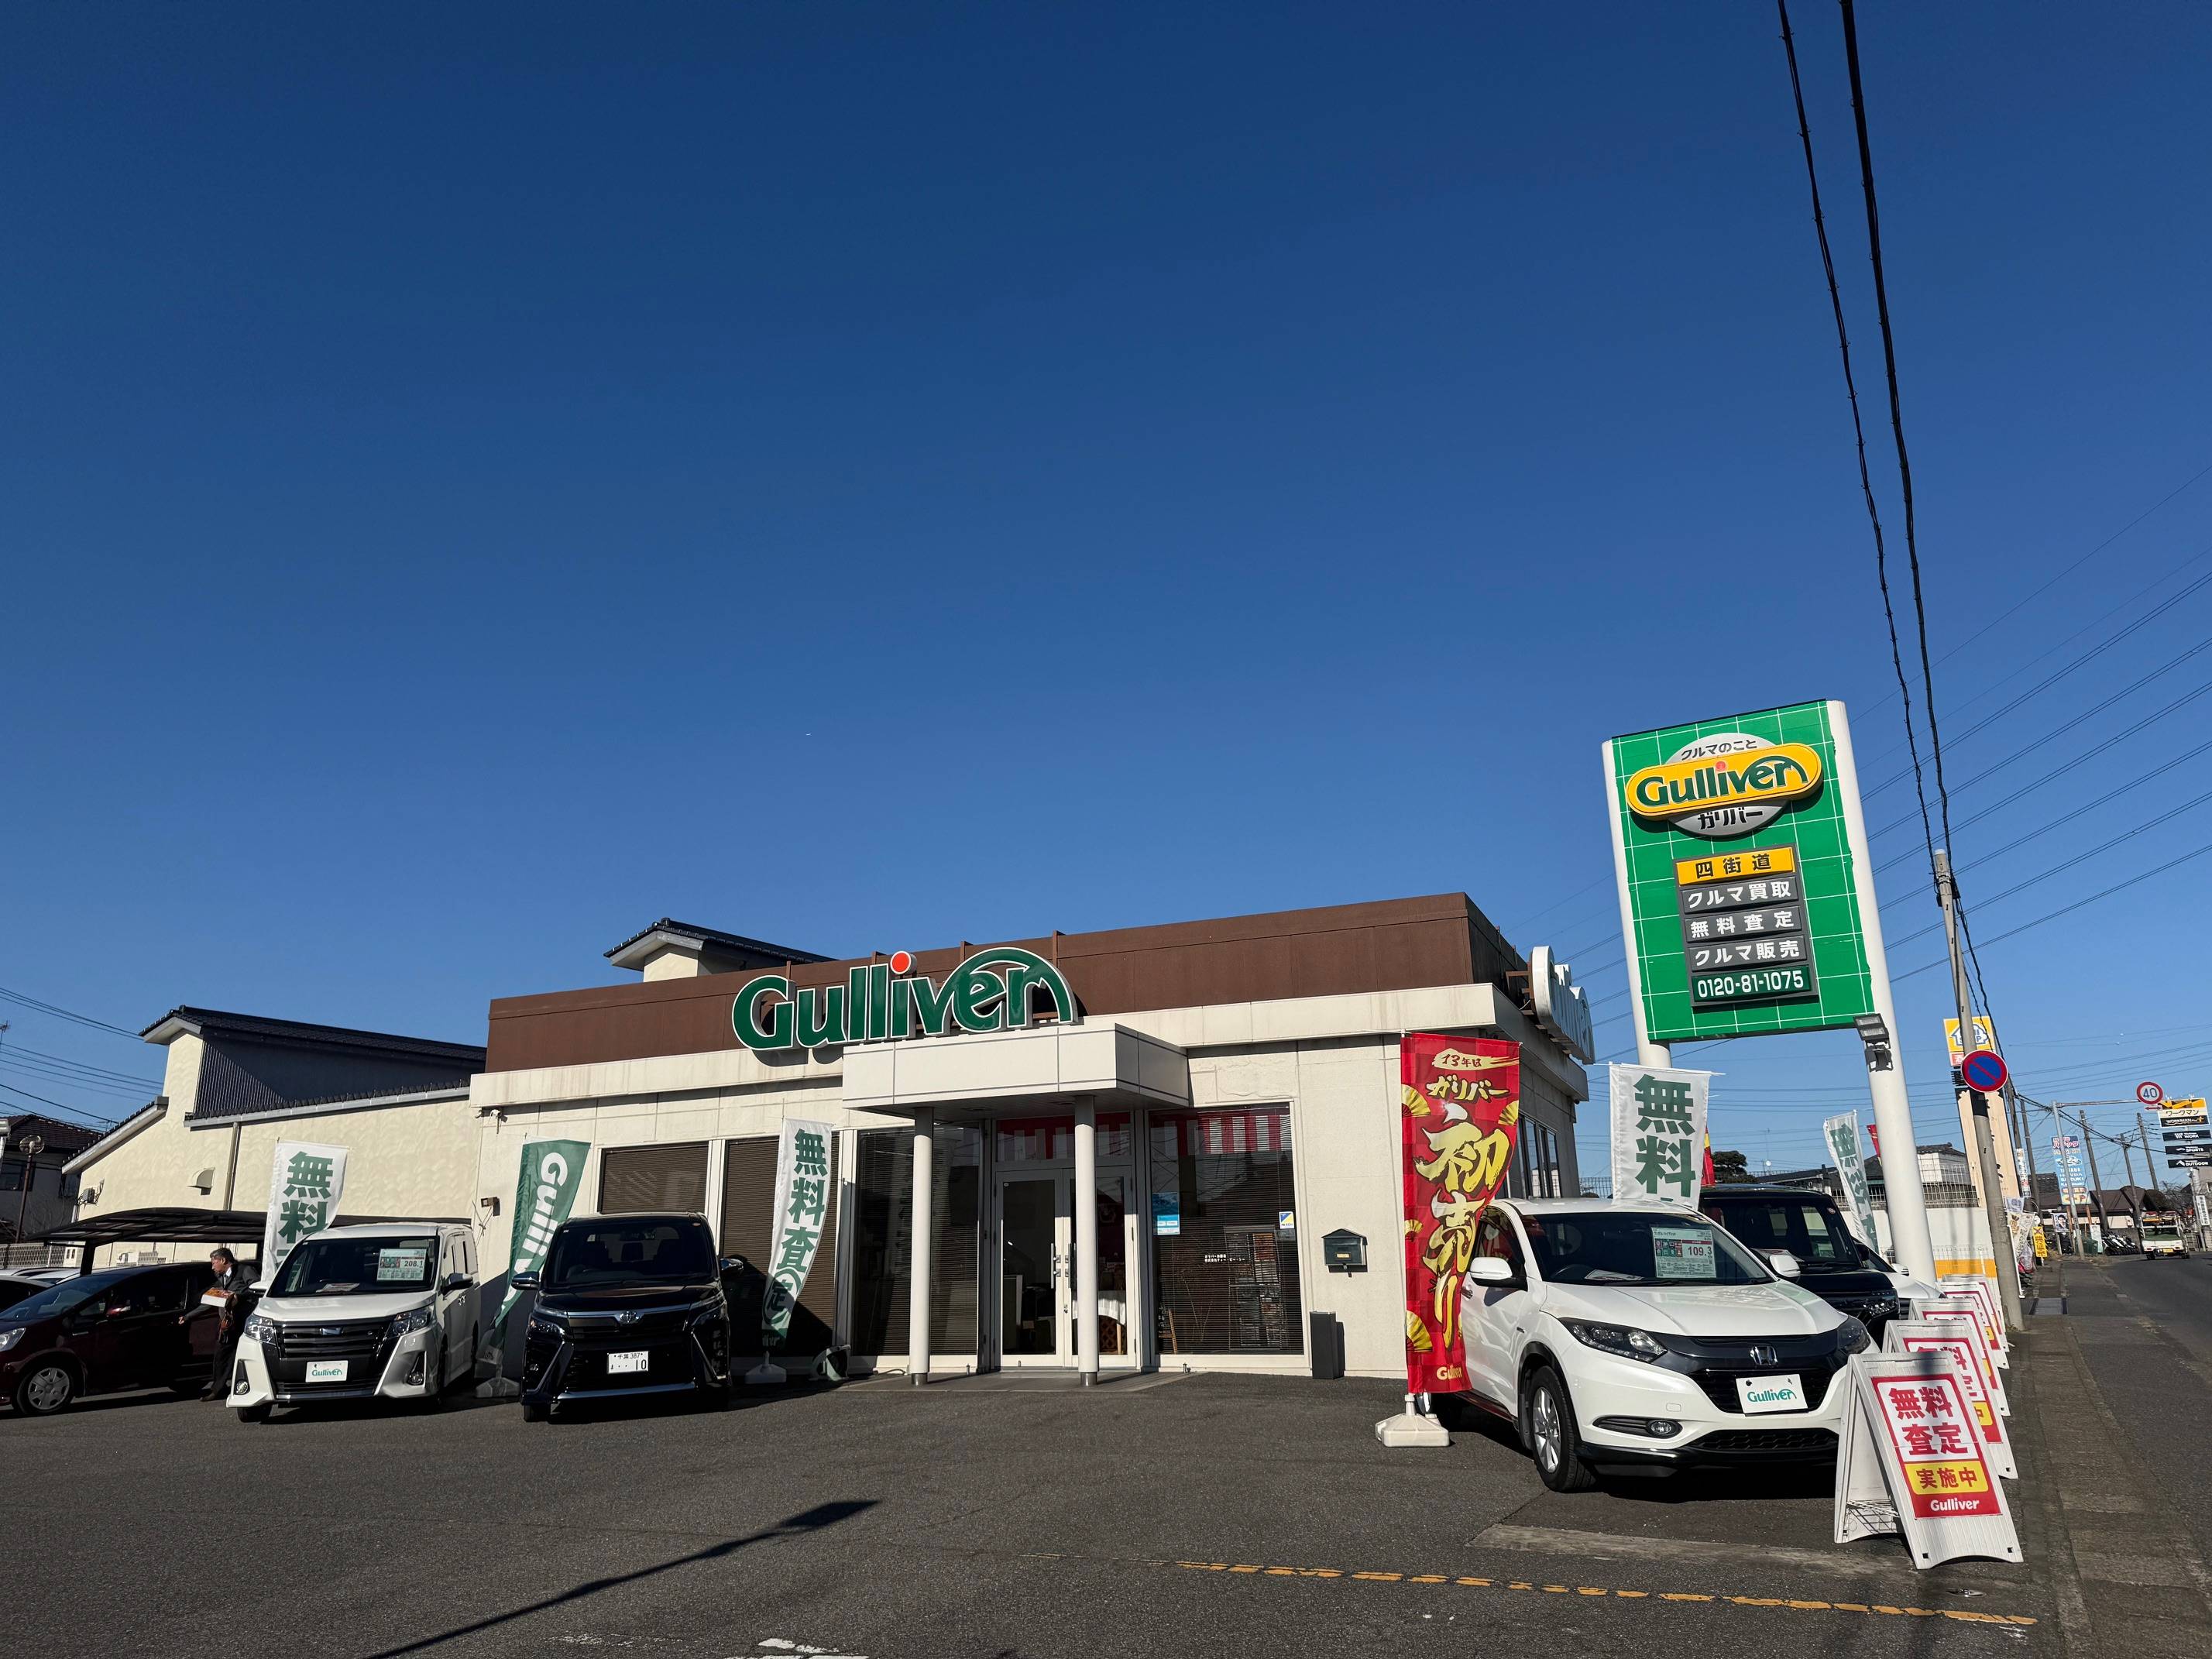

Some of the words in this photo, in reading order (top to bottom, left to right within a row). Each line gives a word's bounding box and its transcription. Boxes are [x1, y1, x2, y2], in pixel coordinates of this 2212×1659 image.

[1681, 740, 1757, 761] クルマのこと
[1636, 755, 1809, 806] Gulliver
[1698, 807, 1764, 830] ガリバー
[1695, 854, 1771, 878] 四街道
[1688, 881, 1791, 908] クルマ買取
[1690, 910, 1795, 939] 無料査定
[1695, 939, 1800, 966] クルマ販売
[1698, 970, 1804, 998] 0120-81-1075
[732, 947, 1075, 1050] Gulliver
[1425, 1074, 1510, 1101] ガリバー
[2143, 1088, 2158, 1098] 40
[1633, 1073, 1696, 1202] 無料
[277, 1151, 334, 1256] 無料
[766, 1128, 828, 1310] 無料査定
[1414, 1102, 1512, 1350] 初売り
[1688, 1246, 1712, 1256] 109.3
[311, 1368, 342, 1376] Gulliver
[1747, 1388, 1798, 1403] Gulliver
[1888, 1385, 1954, 1420] 無料
[1901, 1422, 1969, 1456] 査定
[1915, 1466, 1978, 1490] 実施中
[1930, 1497, 1980, 1512] Gulliver
